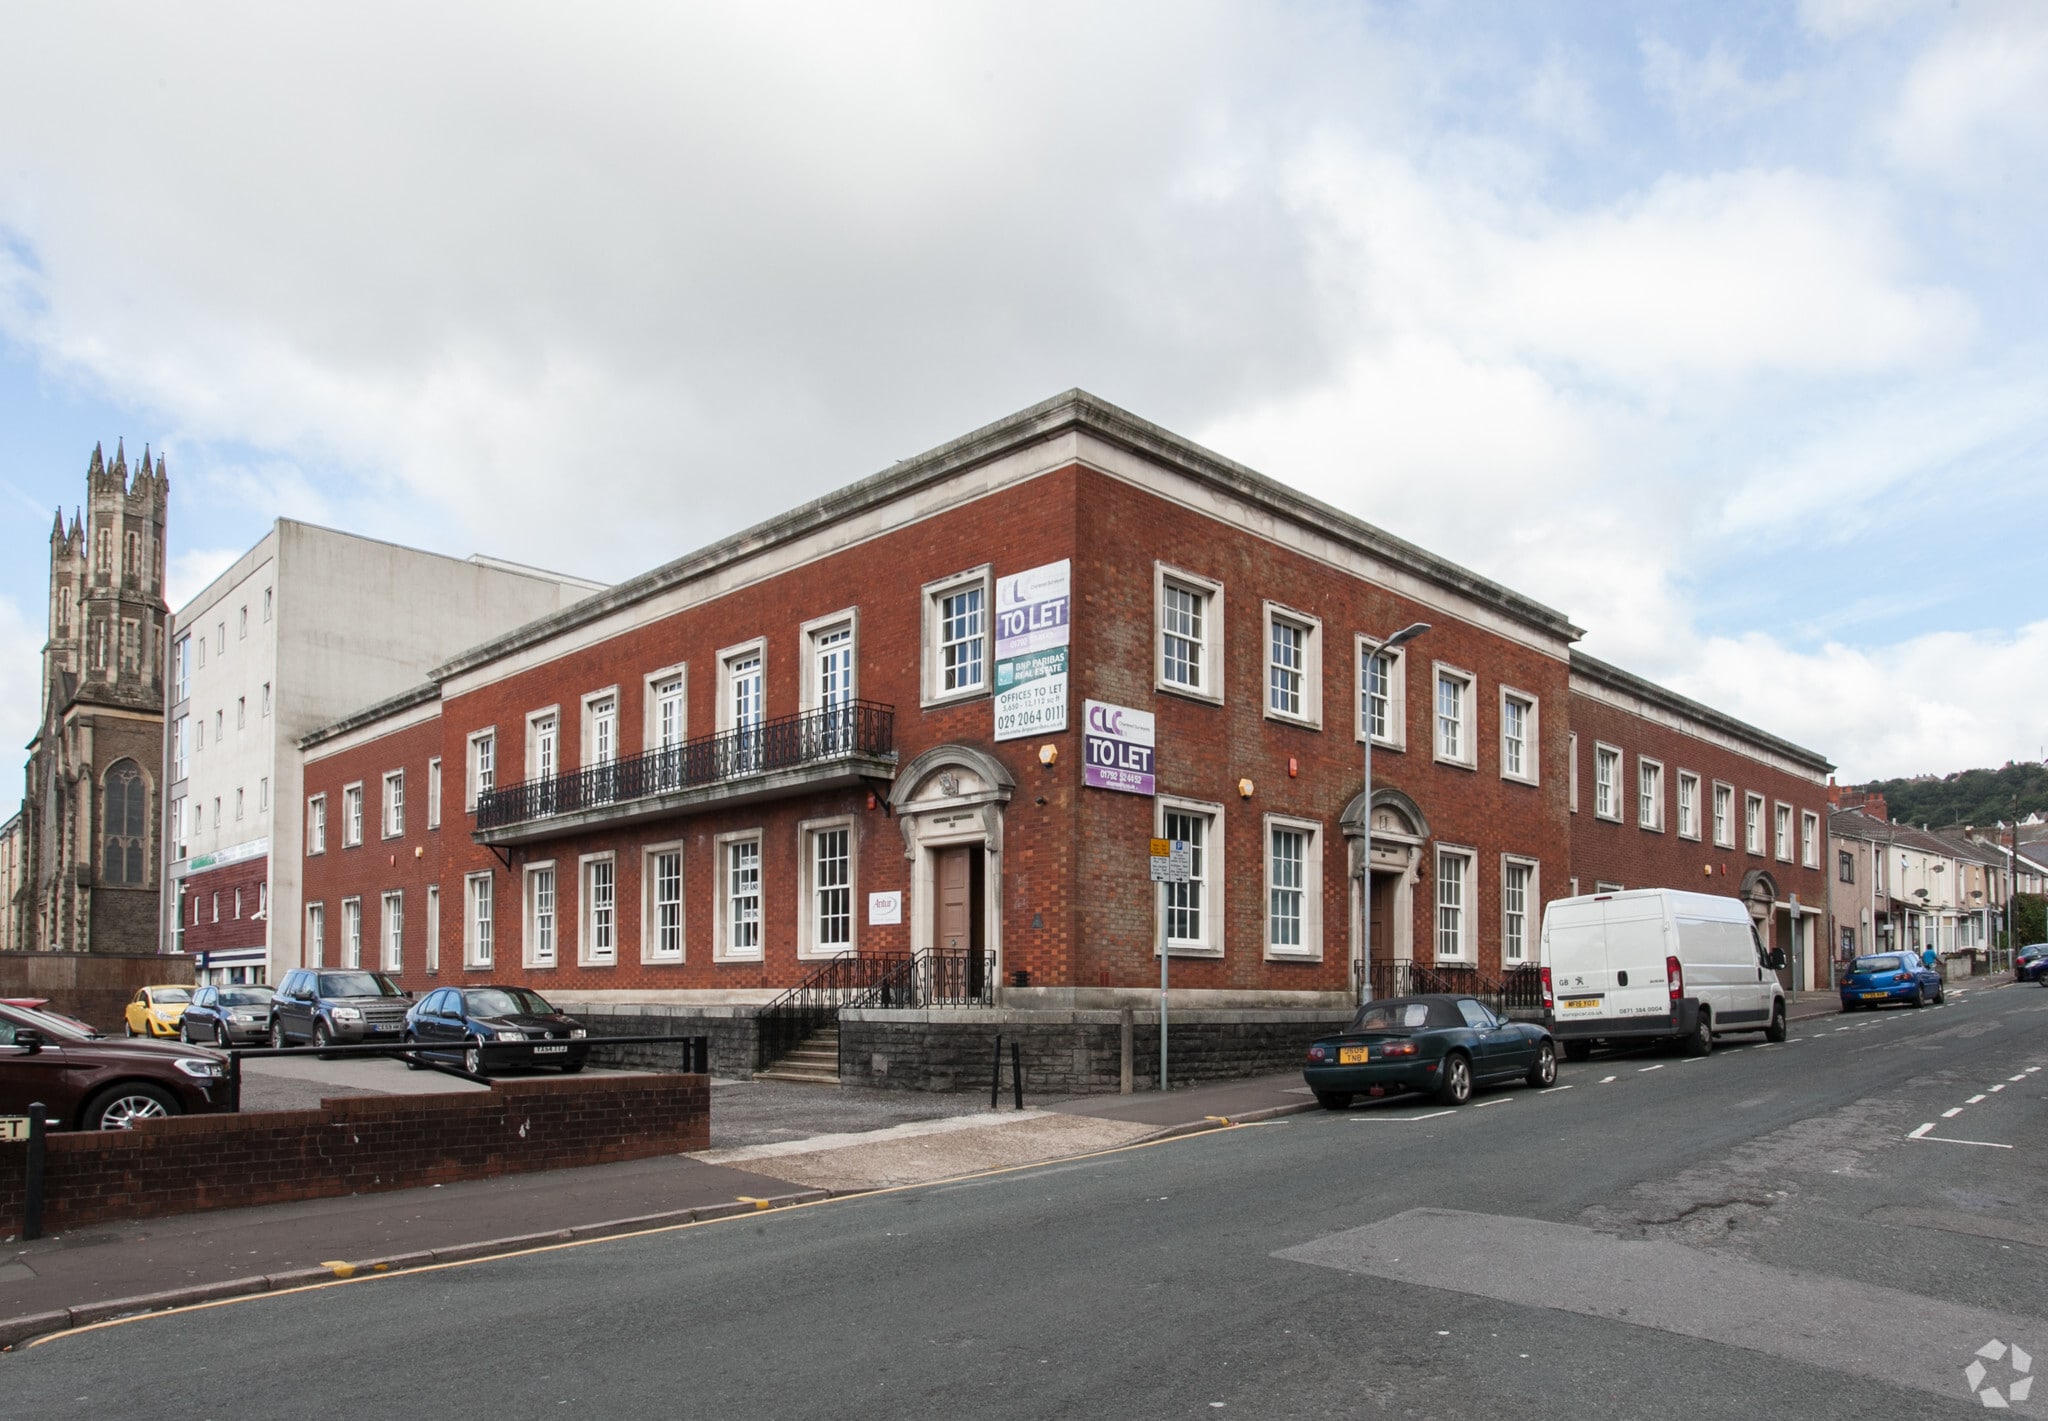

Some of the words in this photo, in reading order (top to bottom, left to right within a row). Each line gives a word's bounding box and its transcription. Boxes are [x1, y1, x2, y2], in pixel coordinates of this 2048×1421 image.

[1000, 609, 1025, 637] TO
[1029, 599, 1065, 631] LET
[1014, 670, 1034, 681] REAL
[1034, 663, 1062, 677] ESTATE
[1015, 661, 1031, 672] BNP
[1032, 652, 1065, 667] PARIBAS
[1000, 690, 1031, 704] OFFICES
[1034, 687, 1046, 697] TO
[1049, 684, 1062, 694] LET
[998, 714, 1016, 730] 029
[1018, 709, 1042, 727] 2064
[1045, 705, 1064, 721] 0111
[1089, 705, 1123, 736] CLC
[1089, 738, 1115, 766] TO
[1118, 743, 1151, 771] LET
[1100, 769, 1118, 780] 01792
